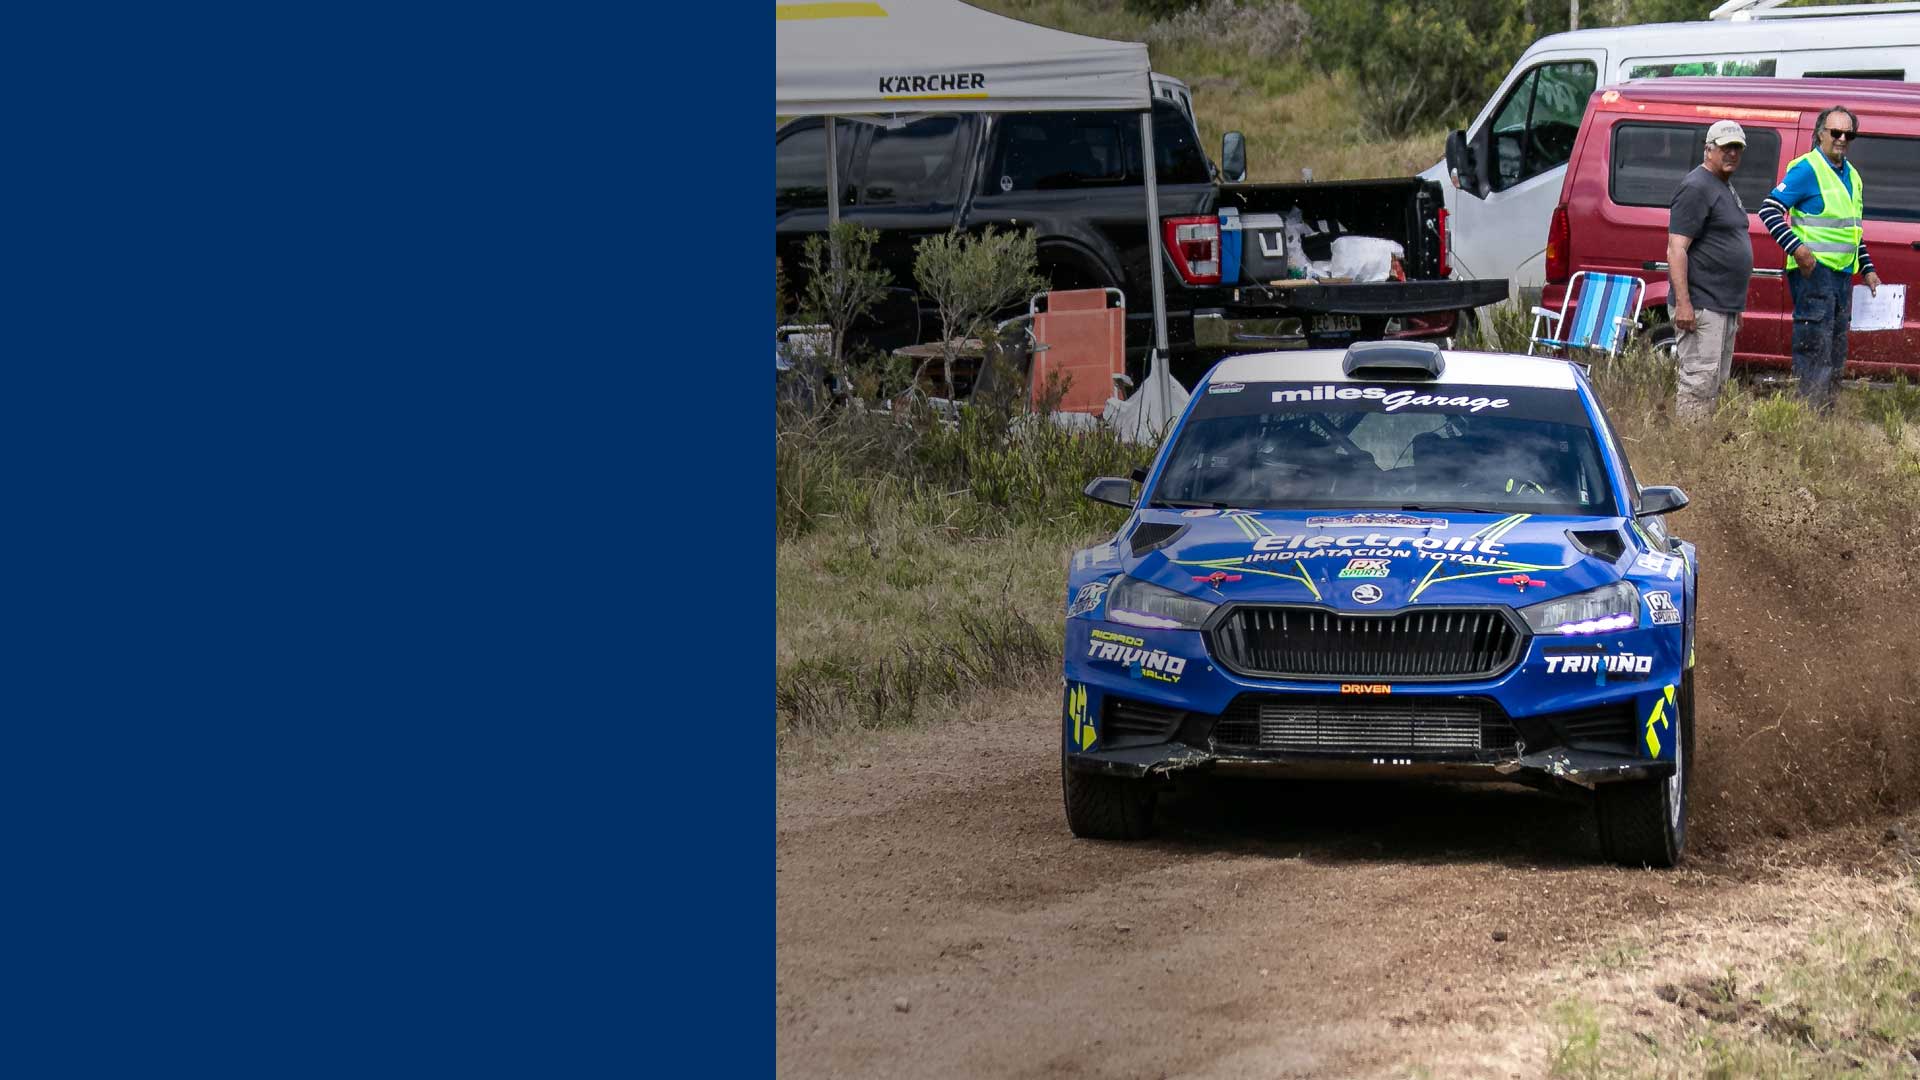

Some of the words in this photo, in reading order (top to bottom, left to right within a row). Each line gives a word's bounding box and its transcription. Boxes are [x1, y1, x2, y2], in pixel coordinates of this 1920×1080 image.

[878, 72, 986, 94] KÄRCHER
[1271, 385, 1387, 403] miles
[1382, 390, 1510, 413] Garage
[1341, 569, 1388, 577] SPORTS
[1650, 592, 1672, 611] PX
[1652, 611, 1680, 623] SPORTS
[1091, 629, 1145, 647] RICARDO
[1087, 639, 1187, 675] TRIVIÑO
[1341, 684, 1391, 695] DRIVEN
